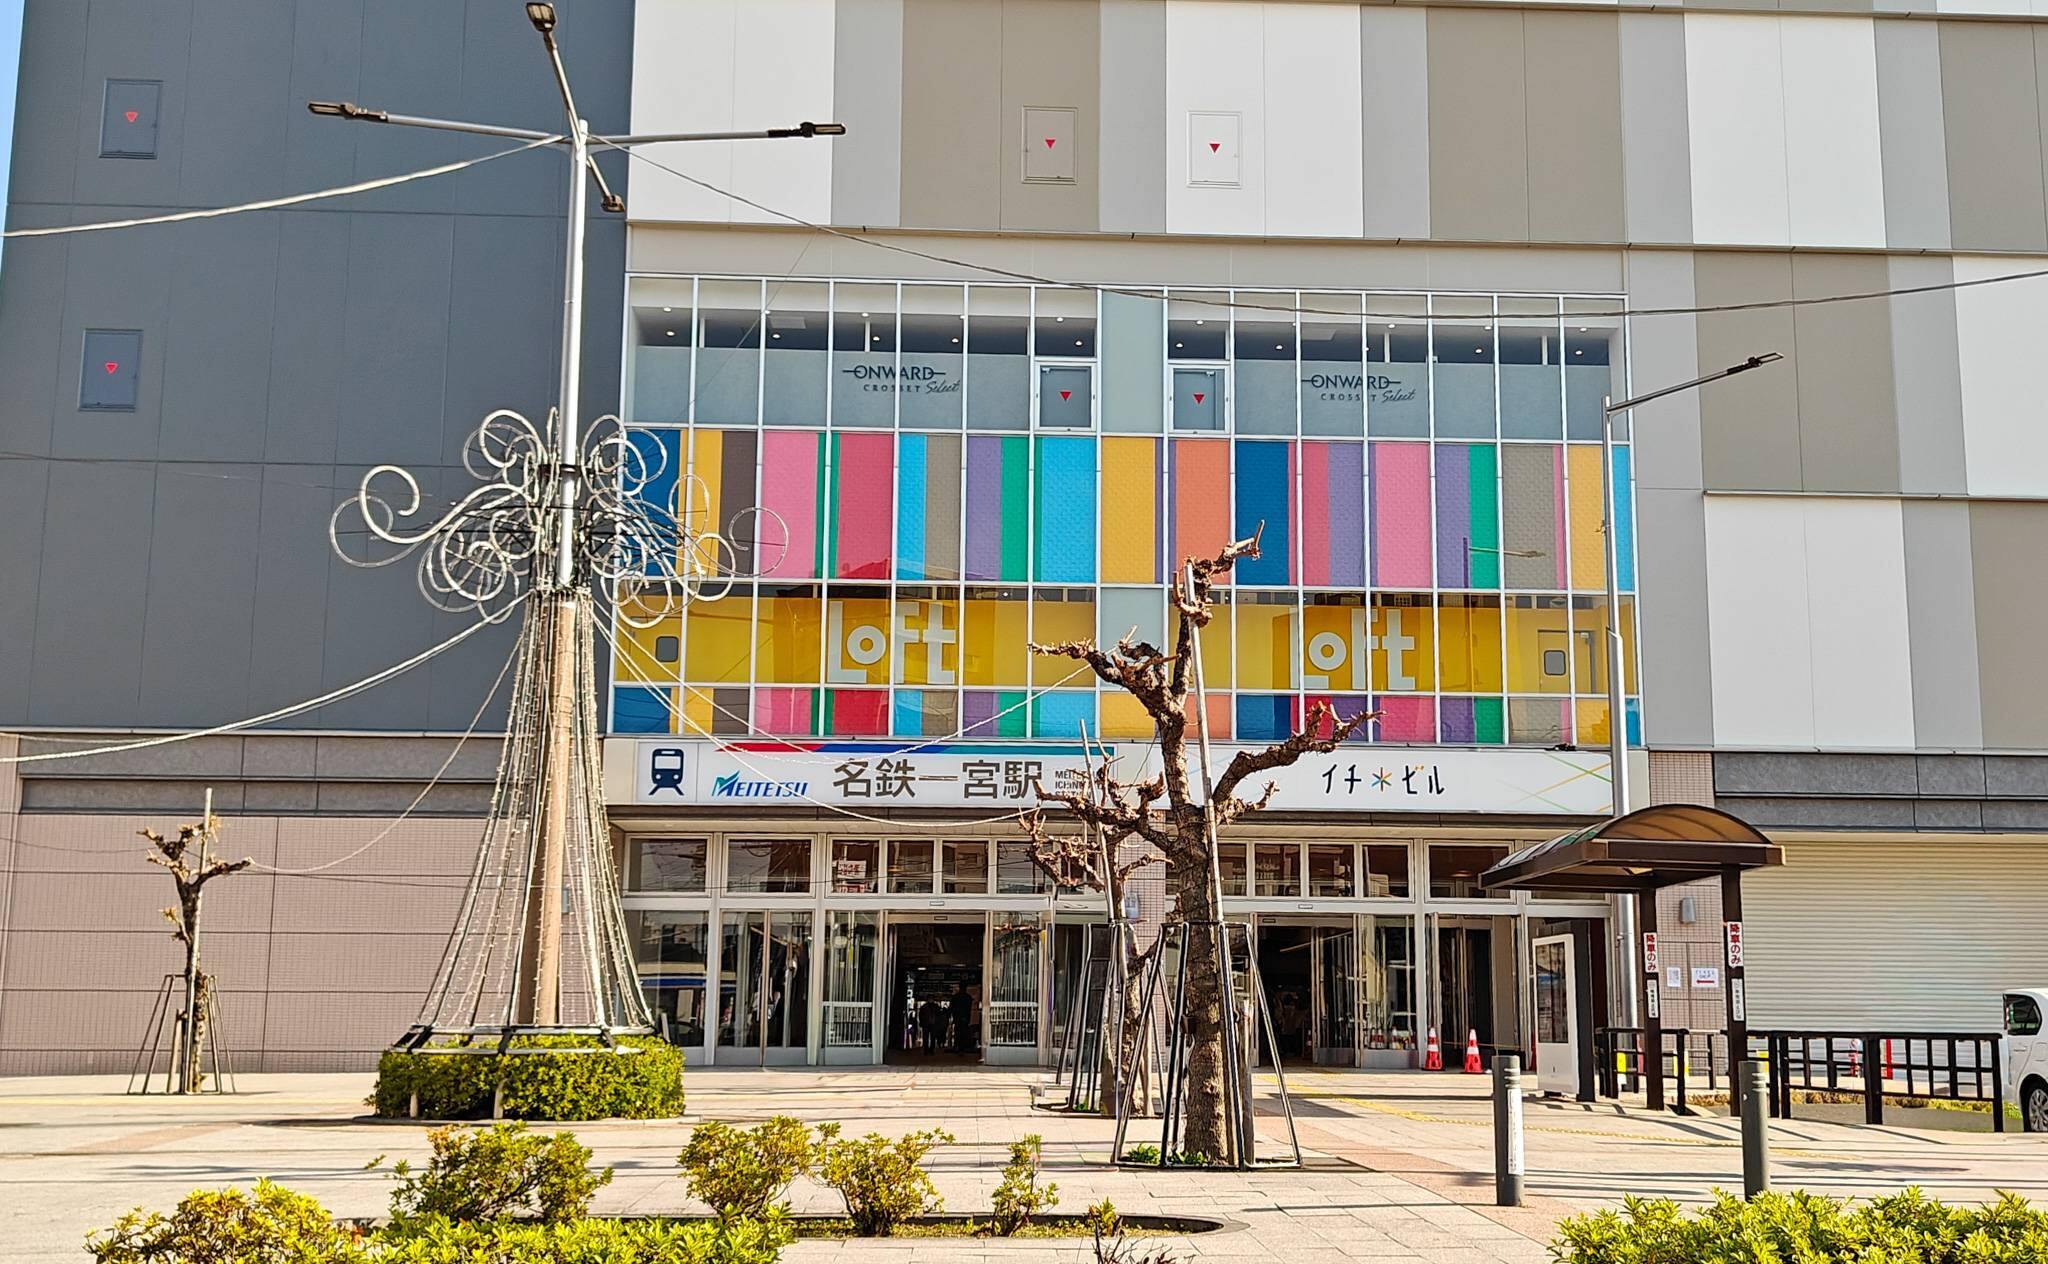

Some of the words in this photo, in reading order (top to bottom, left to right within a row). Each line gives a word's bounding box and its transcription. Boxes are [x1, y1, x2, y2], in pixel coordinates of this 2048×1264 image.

[853, 365, 935, 380] ONWARD
[925, 380, 960, 394] Select
[1311, 374, 1390, 389] ONWARD
[1321, 393, 1377, 402] CROSST
[1382, 389, 1416, 403] Select
[711, 770, 808, 798] MEITETSU
[832, 758, 1043, 799] 名鉄一宮駅
